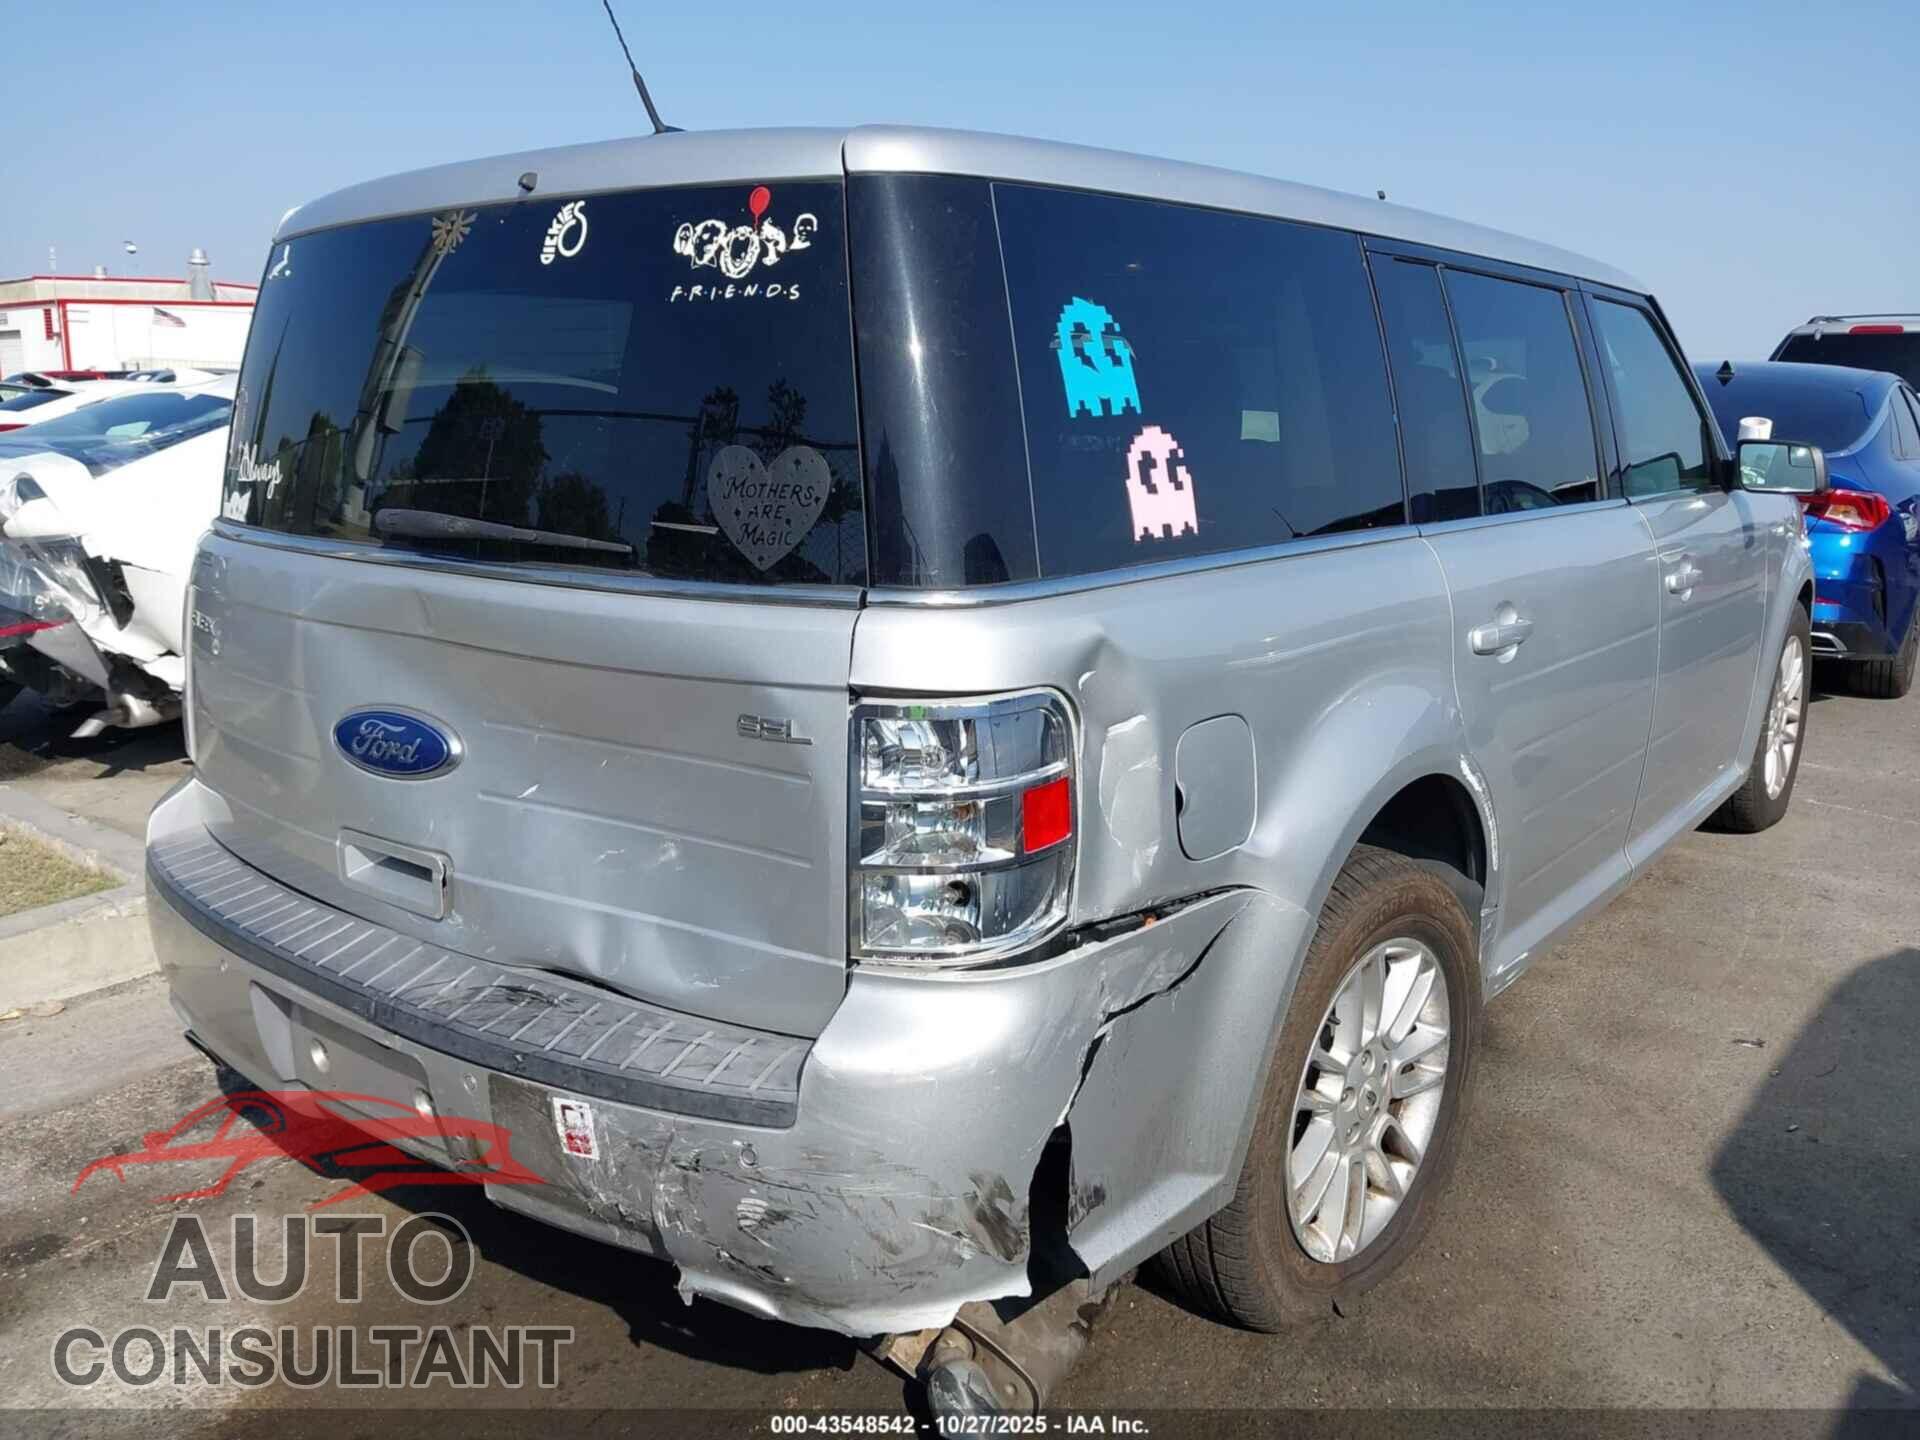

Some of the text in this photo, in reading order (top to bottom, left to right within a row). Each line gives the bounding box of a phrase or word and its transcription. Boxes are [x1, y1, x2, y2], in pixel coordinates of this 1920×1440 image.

[723, 477, 815, 507] MOTHERS
[747, 504, 785, 519] ARE
[736, 522, 793, 546] MAGIC
[352, 719, 422, 763] Ford
